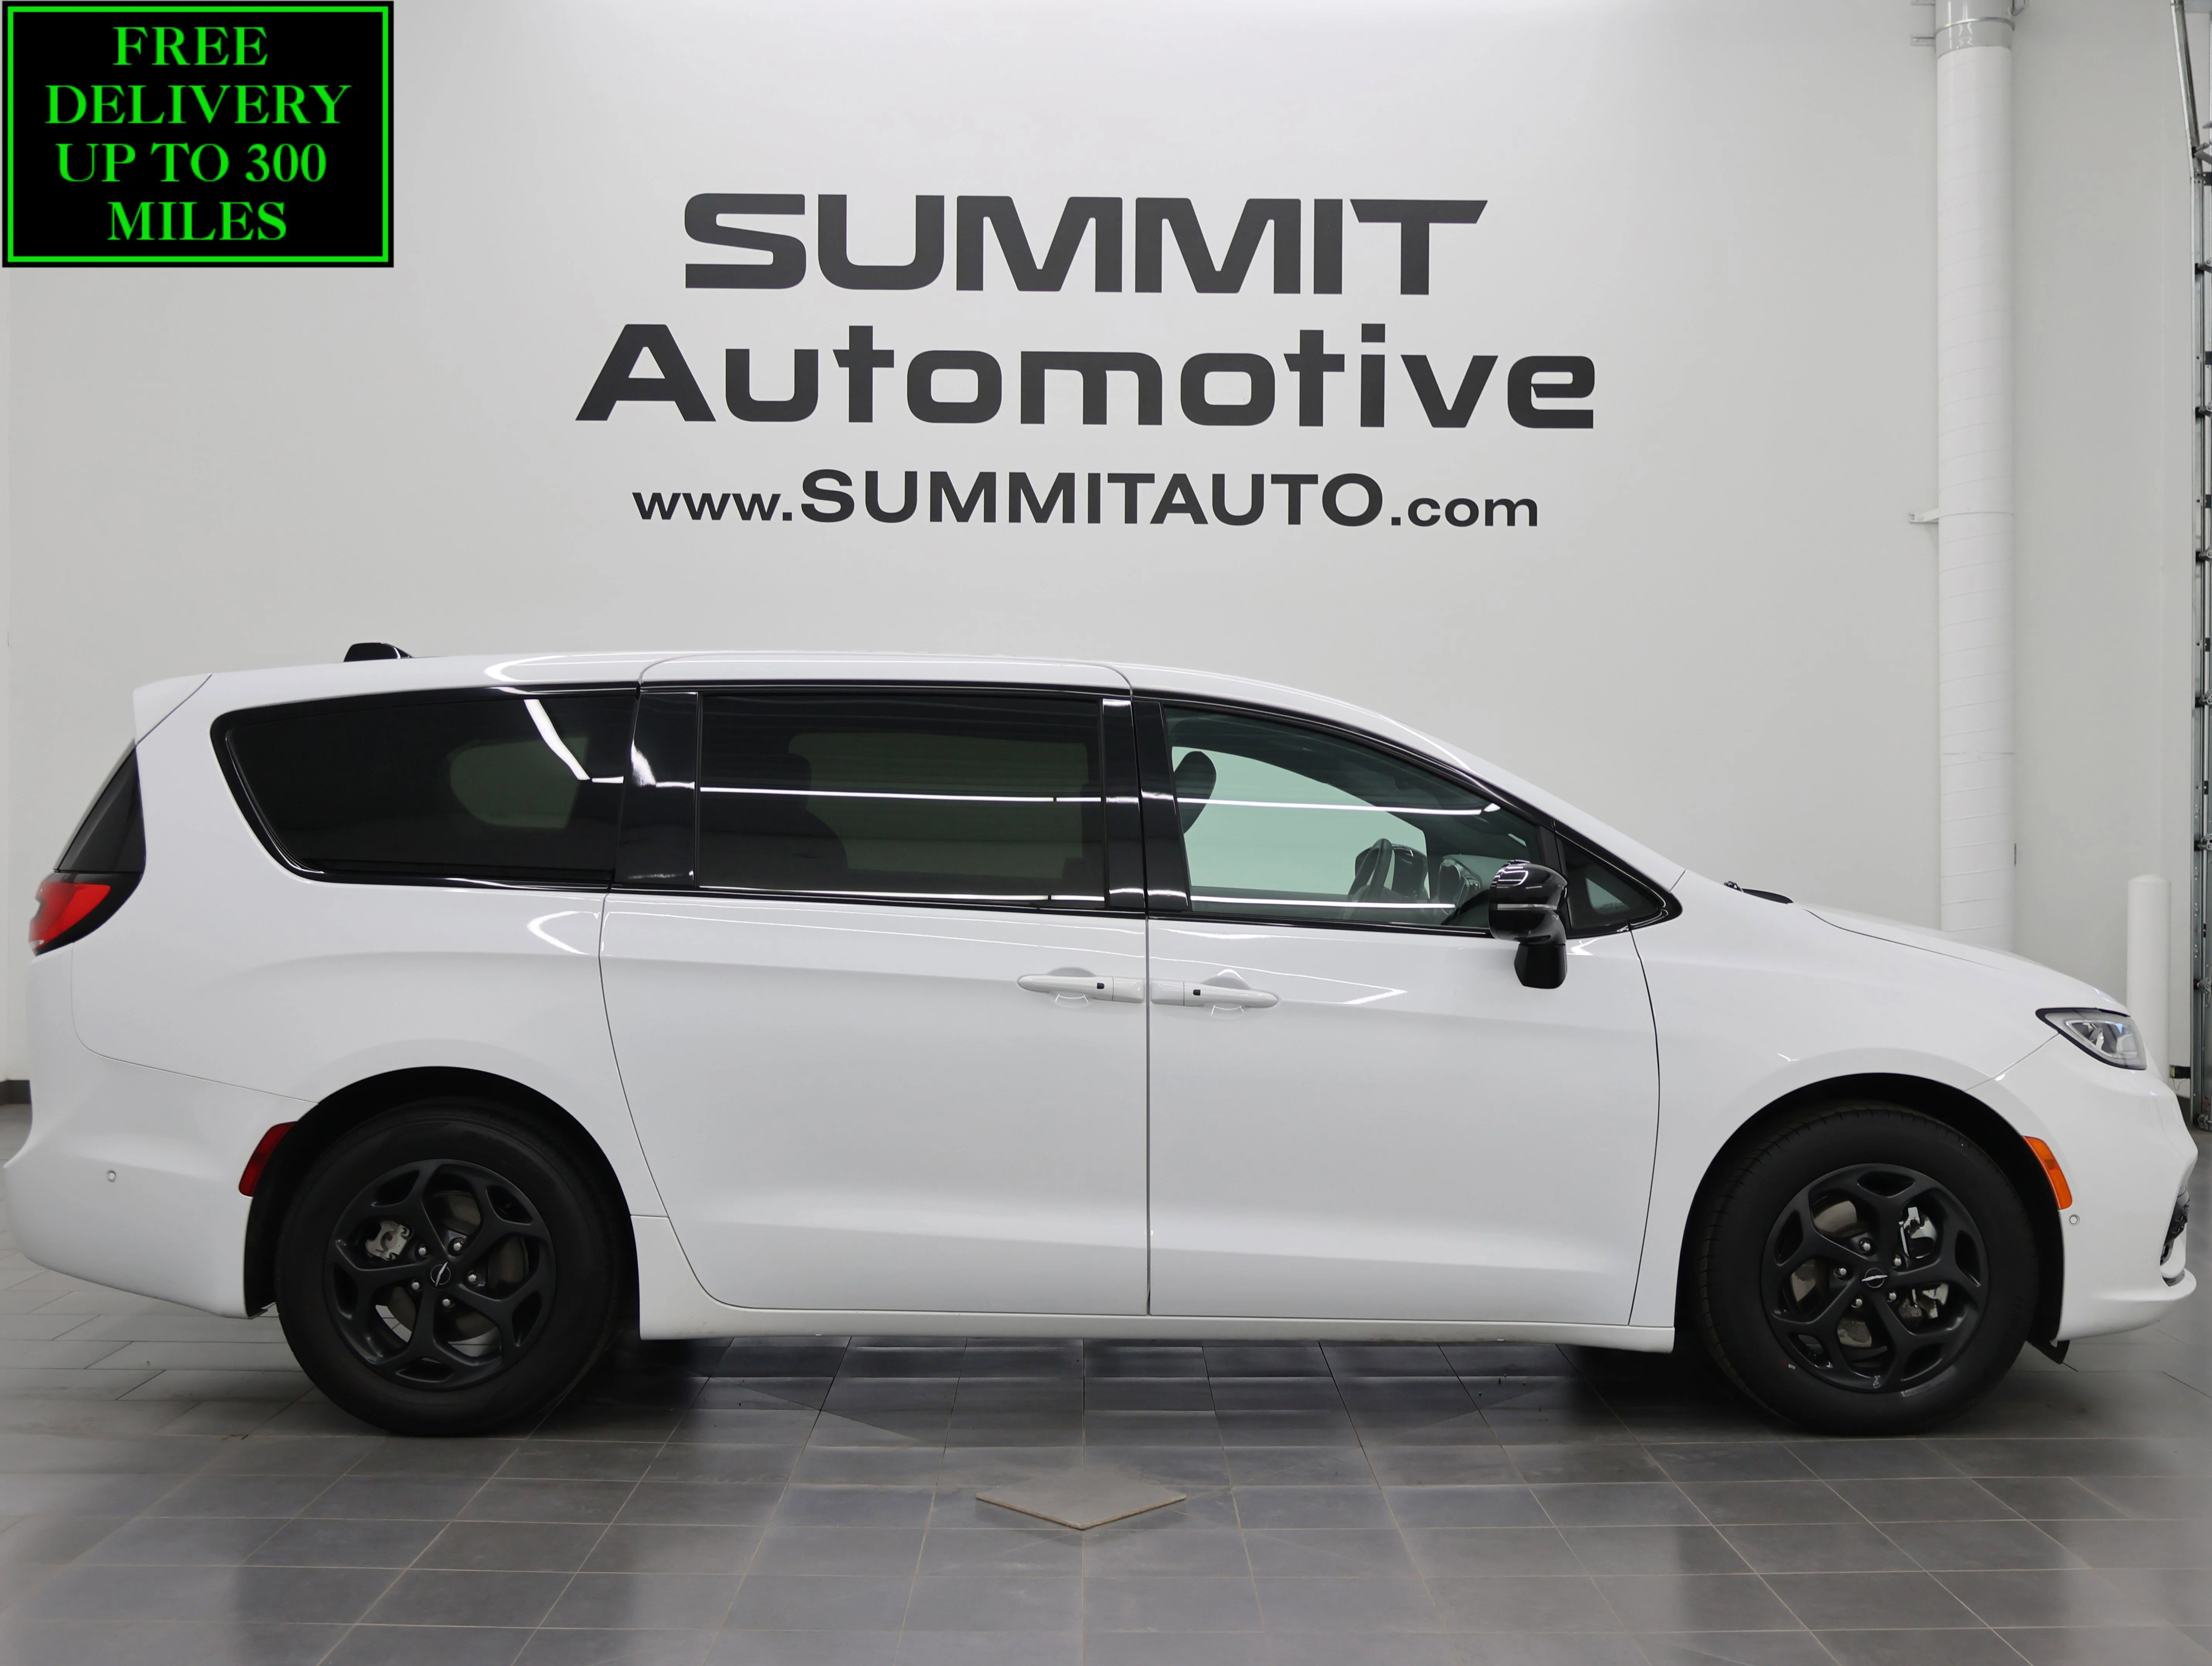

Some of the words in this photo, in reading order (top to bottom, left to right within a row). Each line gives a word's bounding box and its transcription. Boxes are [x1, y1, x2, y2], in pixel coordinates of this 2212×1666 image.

[684, 193, 1488, 295] SUMMIT
[575, 323, 1595, 429] Automotive
[632, 469, 1537, 527] www.SUMMITAUTO.com
